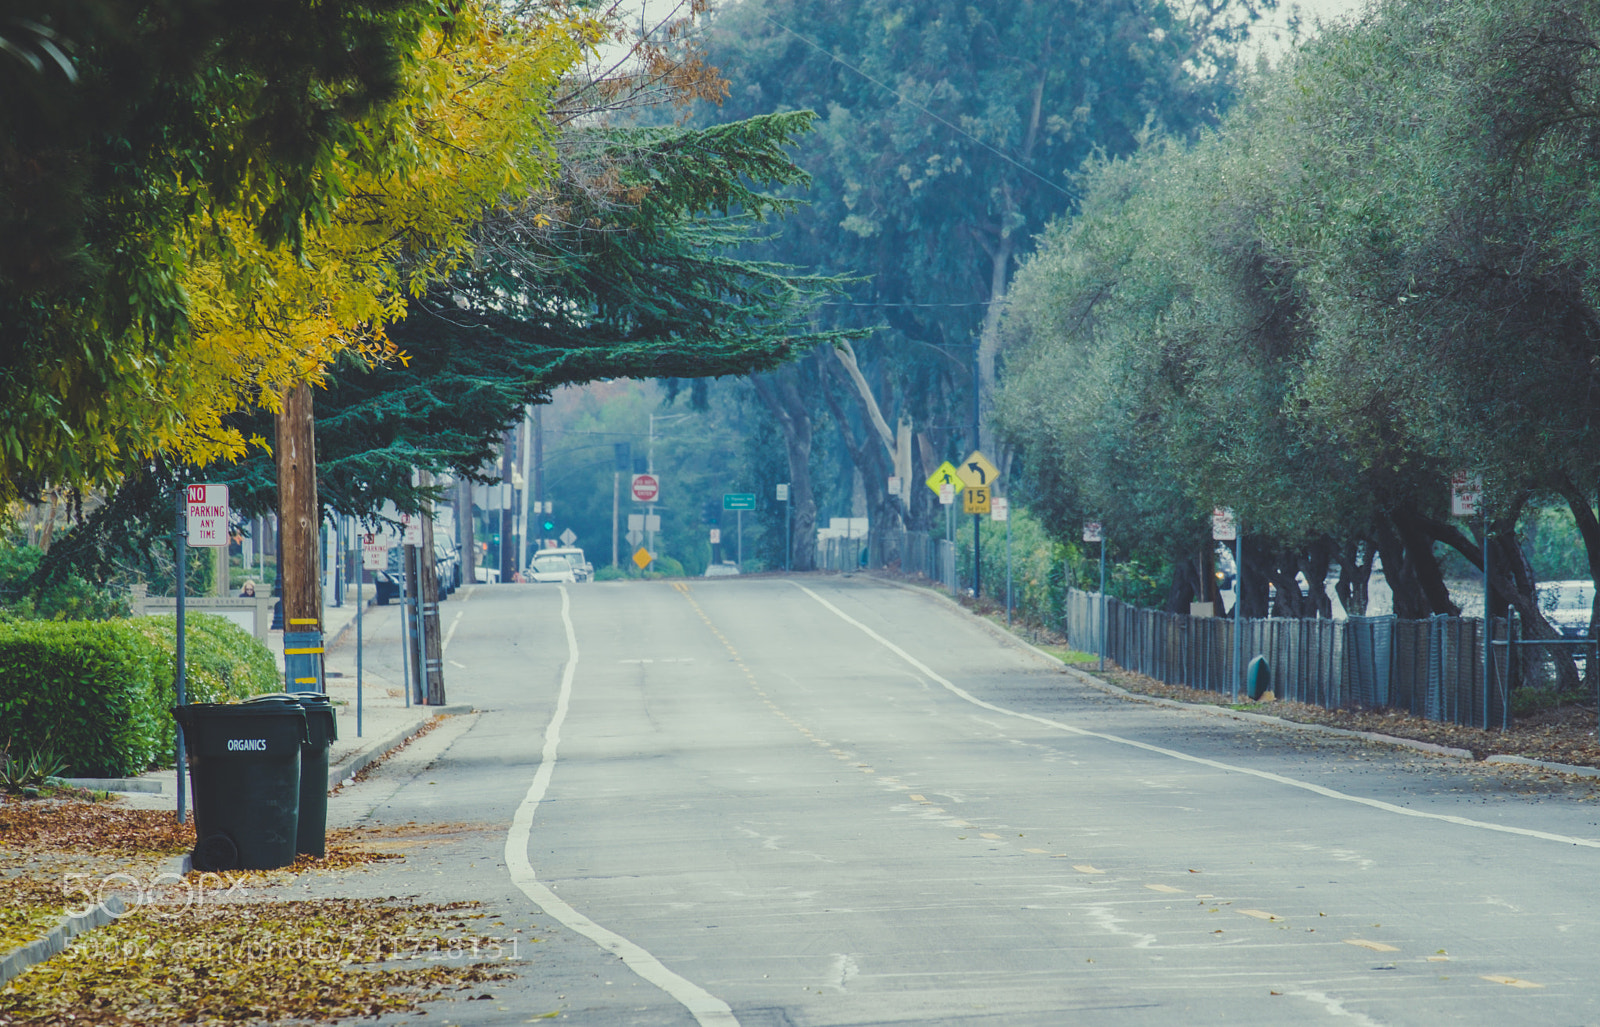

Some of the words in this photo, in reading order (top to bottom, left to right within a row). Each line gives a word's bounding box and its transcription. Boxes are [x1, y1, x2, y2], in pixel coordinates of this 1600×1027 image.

[189, 487, 204, 501] NO
[968, 490, 986, 504] 15
[190, 505, 225, 517] PARKING
[200, 519, 214, 528] ANY
[200, 530, 216, 539] TIME
[227, 739, 267, 751] ORGANICS
